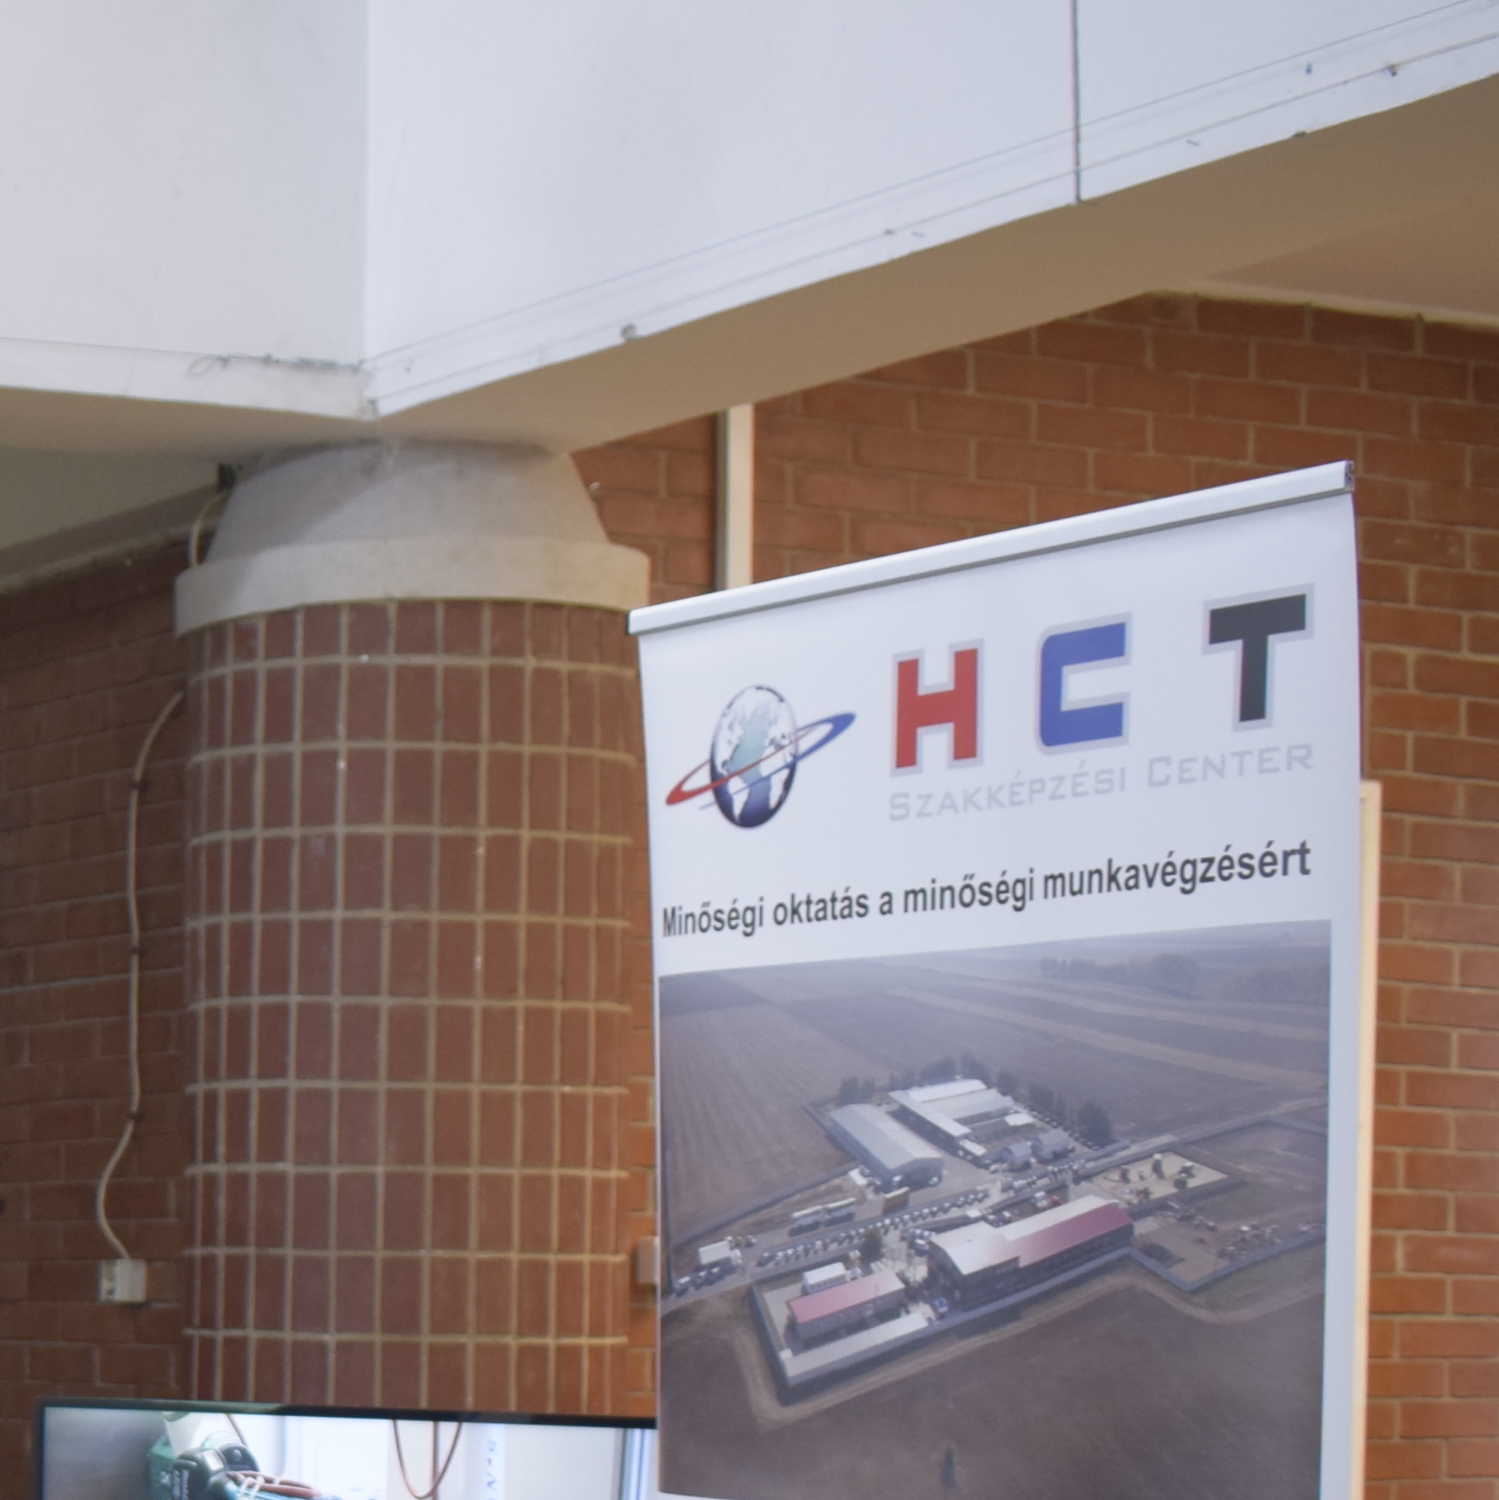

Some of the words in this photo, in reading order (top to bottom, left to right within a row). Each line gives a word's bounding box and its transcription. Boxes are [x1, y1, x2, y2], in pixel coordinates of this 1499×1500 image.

[892, 588, 1311, 774] HCT
[1147, 743, 1314, 788] CENTER
[662, 896, 765, 938] Minőségi
[772, 886, 870, 926] oktatás
[879, 890, 894, 916] a
[902, 868, 1035, 913] minőségi
[1043, 839, 1311, 899] munkavégzésért
